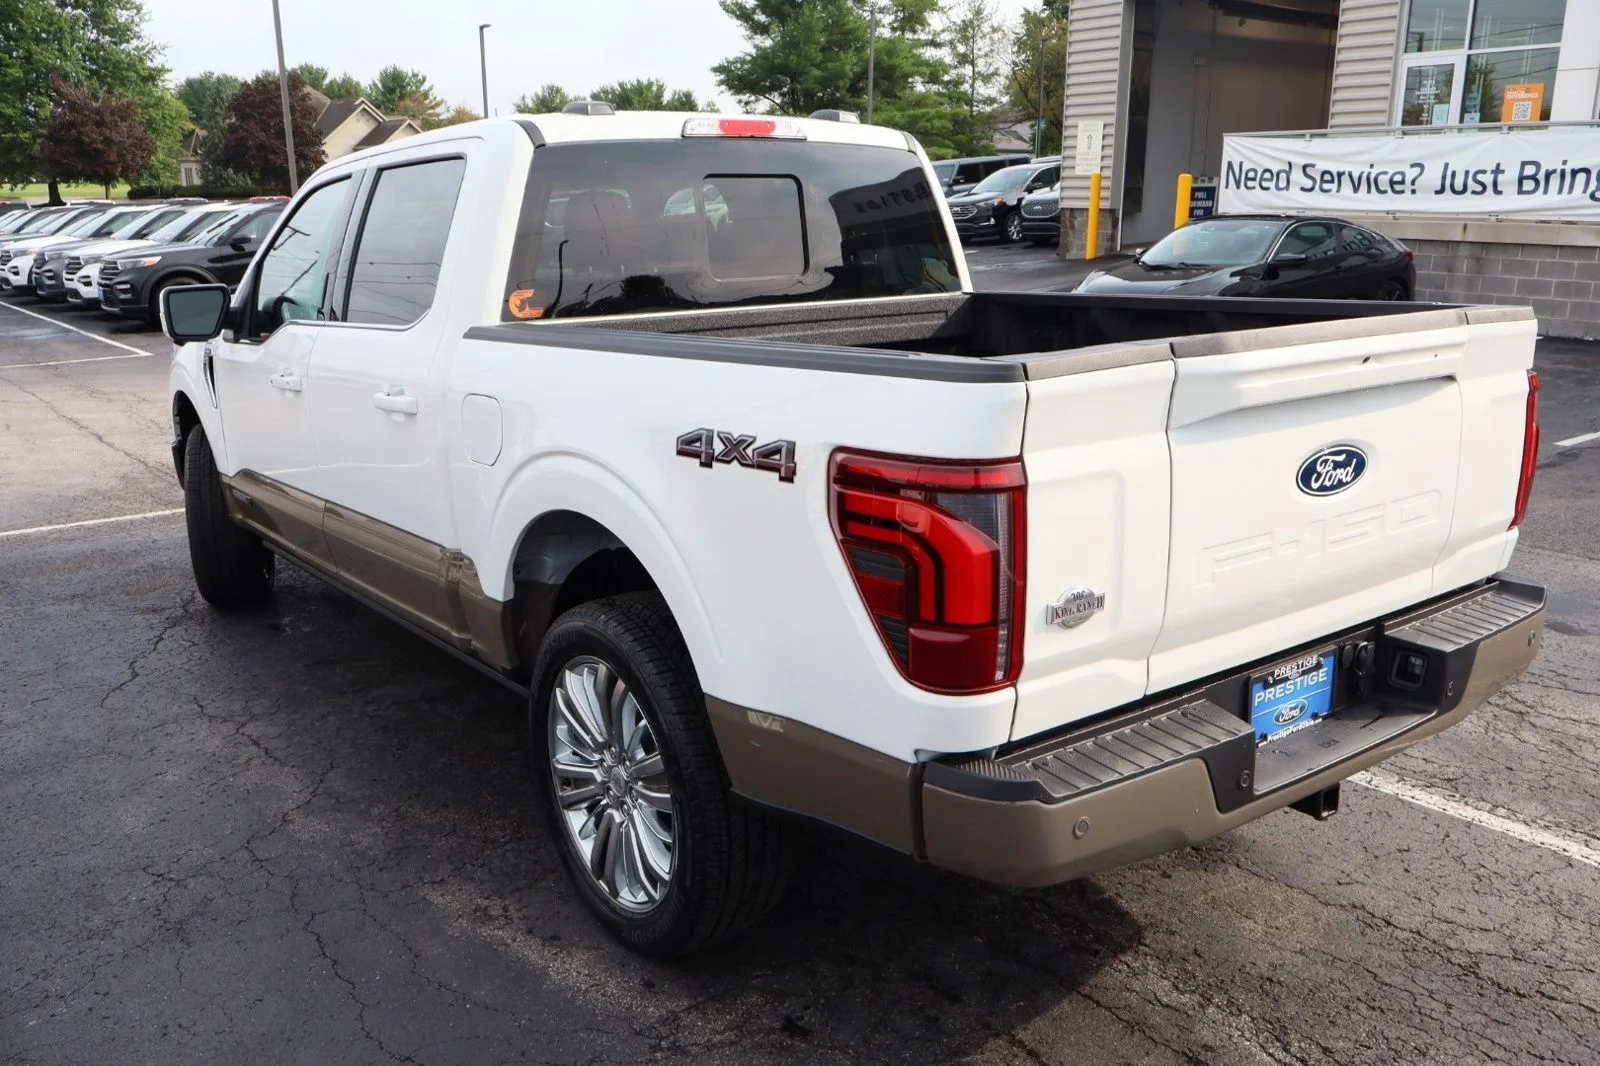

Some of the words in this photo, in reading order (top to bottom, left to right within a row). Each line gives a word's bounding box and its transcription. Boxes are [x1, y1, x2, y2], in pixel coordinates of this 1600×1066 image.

[1225, 160, 1293, 192] Need
[1300, 162, 1425, 195] Service?
[1434, 162, 1506, 196] Just
[1311, 453, 1357, 489] Ford
[1192, 488, 1442, 590] F-150
[1274, 654, 1318, 678] PRESTIGE
[1254, 667, 1328, 707] PRESTIGE
[1279, 702, 1302, 722] Ford
